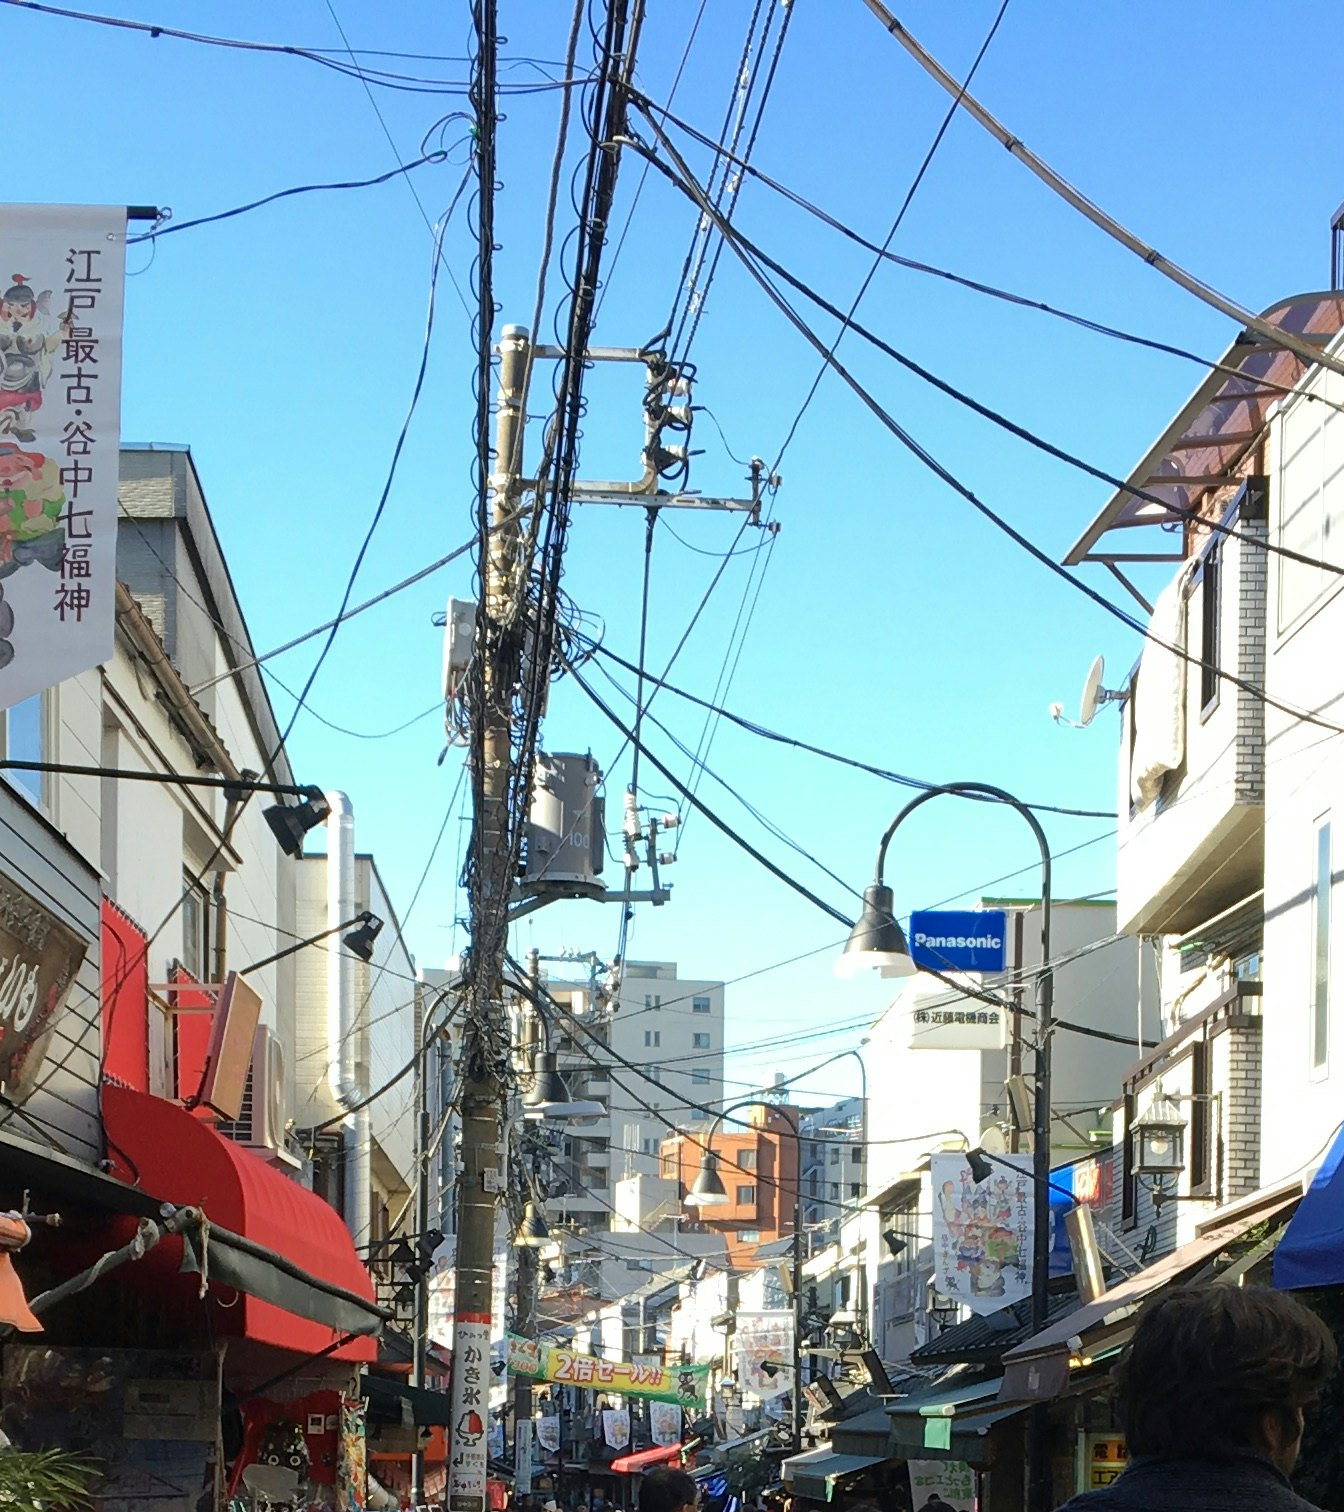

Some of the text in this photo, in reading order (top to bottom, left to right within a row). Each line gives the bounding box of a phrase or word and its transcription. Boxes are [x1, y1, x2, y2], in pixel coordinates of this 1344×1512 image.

[54, 248, 102, 622] 江戸最古・谷中七福神
[914, 933, 1002, 949] Panasonic
[462, 1345, 482, 1406] かき氷
[556, 1353, 664, 1386] 2倍セール!!
